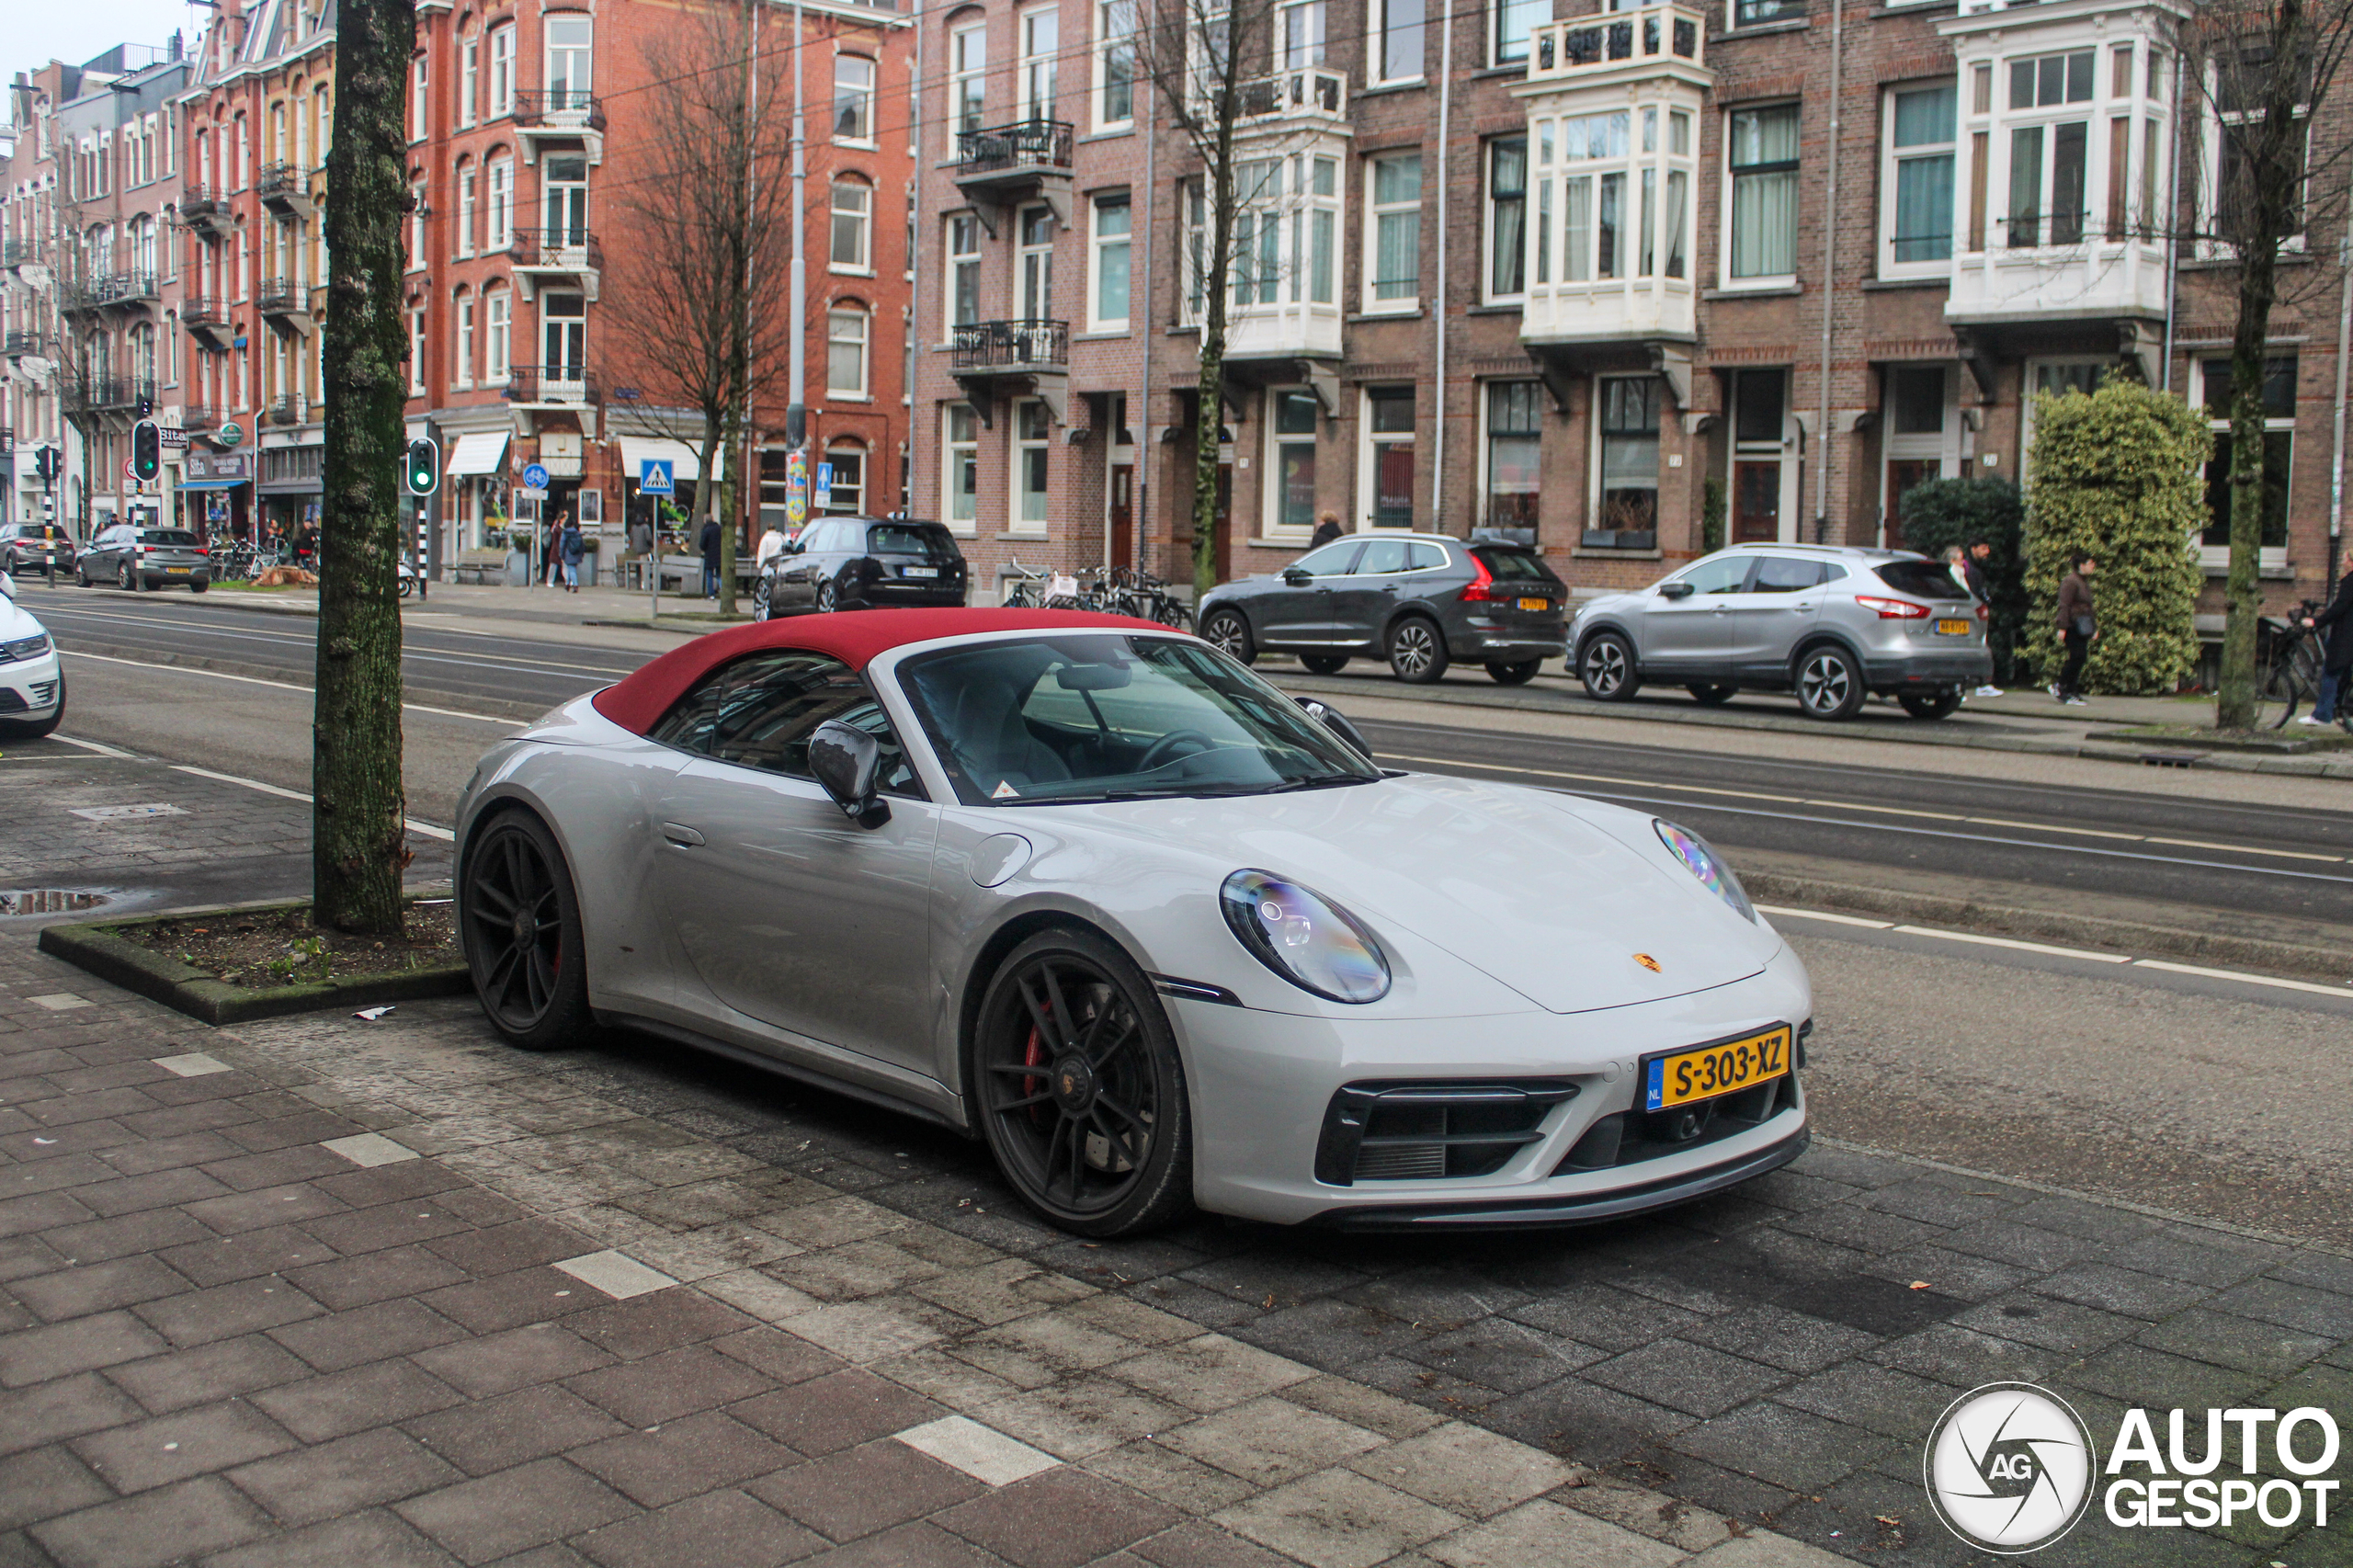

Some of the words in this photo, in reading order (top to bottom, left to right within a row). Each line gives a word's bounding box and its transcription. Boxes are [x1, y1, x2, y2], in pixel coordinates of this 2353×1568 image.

[160, 429, 188, 441] Sita
[190, 458, 205, 475] Sita
[1676, 1035, 1782, 1096] S-303-XZ
[1648, 1089, 1661, 1101] NL
